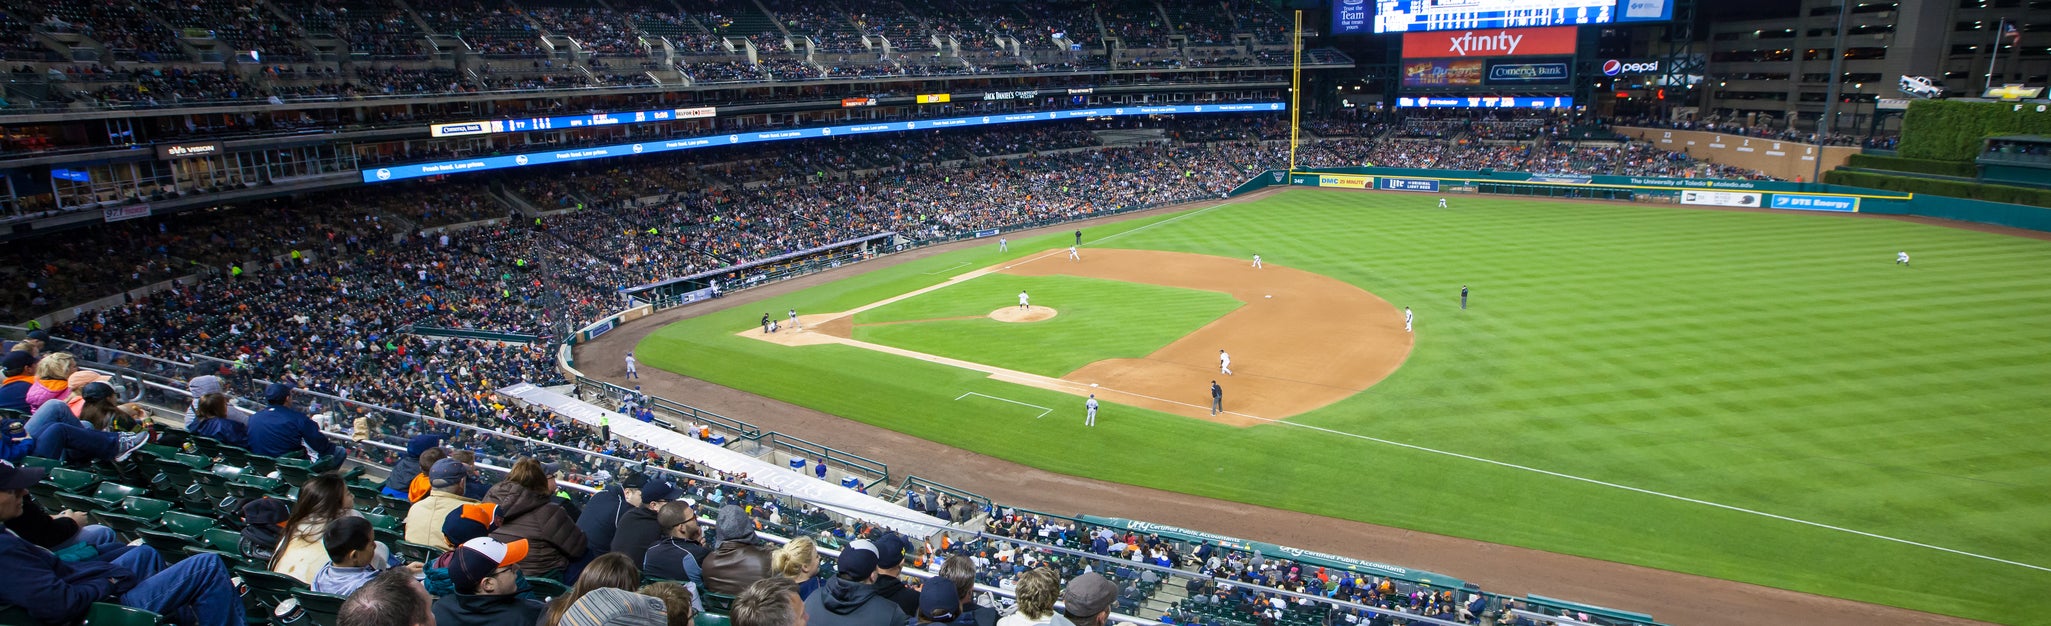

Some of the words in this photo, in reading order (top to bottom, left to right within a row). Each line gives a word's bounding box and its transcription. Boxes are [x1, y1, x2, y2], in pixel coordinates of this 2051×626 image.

[1341, 11, 1364, 20] Team
[1449, 31, 1523, 55] xfinity
[1539, 67, 1561, 75] Bank
[1622, 61, 1658, 73] pepsi
[1390, 179, 1404, 188] Lite
[1813, 199, 1849, 209] Energy
[1150, 523, 1178, 532] Certified
[1179, 528, 1198, 536] Public
[1200, 532, 1240, 542] Accountants
[1304, 550, 1335, 560] Certified
[1337, 556, 1359, 564] Public
[1360, 560, 1405, 574] Accountants
